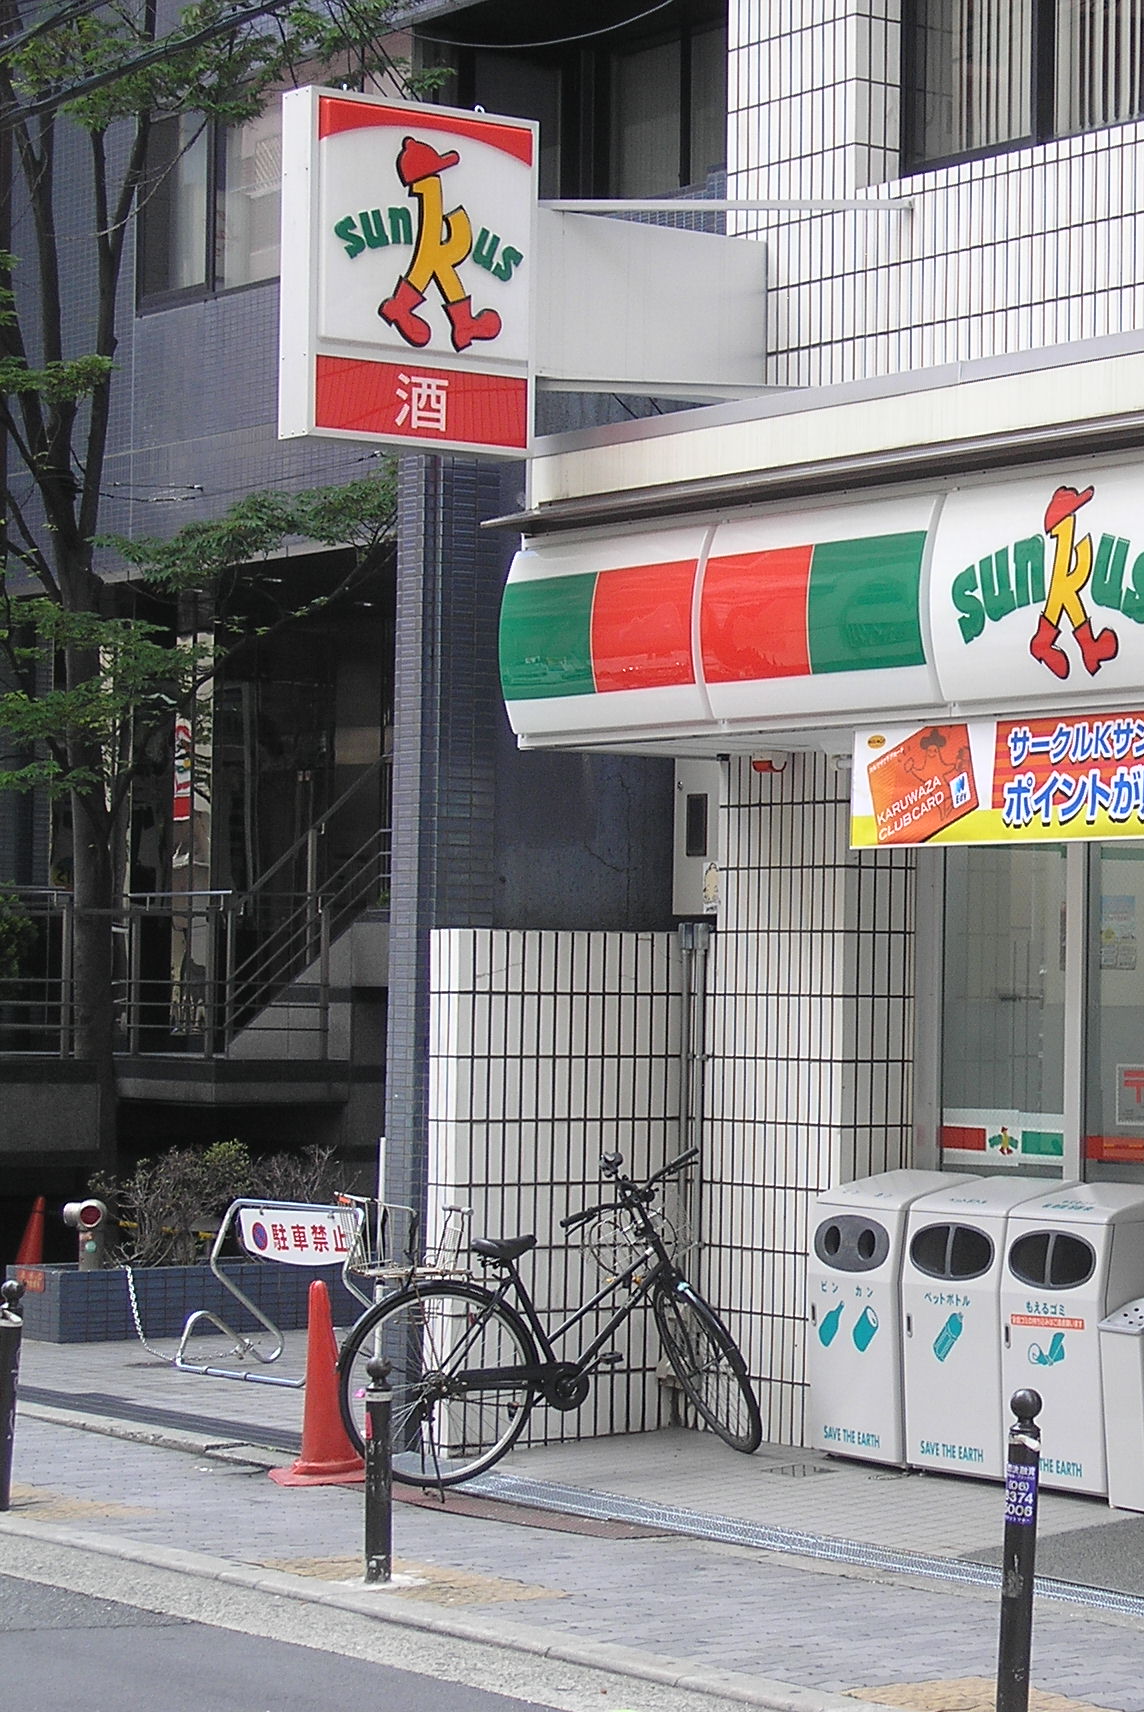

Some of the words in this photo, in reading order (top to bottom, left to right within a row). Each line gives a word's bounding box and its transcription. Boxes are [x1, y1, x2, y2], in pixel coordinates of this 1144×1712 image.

[394, 372, 449, 432] 酒
[876, 775, 942, 826] KARUWAZA
[270, 1223, 348, 1254] 駐車禁止
[854, 1284, 874, 1299] カン
[923, 1292, 971, 1308] ペットボトル
[1024, 1301, 1066, 1317] もえるゴミ
[823, 1425, 842, 1442] SAVE
[842, 1428, 858, 1445] THE
[857, 1431, 881, 1449] EARTH
[920, 1440, 940, 1457] SAVE
[941, 1443, 958, 1460] THE
[958, 1446, 984, 1463] EARTH
[1039, 1457, 1055, 1474] THE
[1055, 1459, 1083, 1478] EARTH
